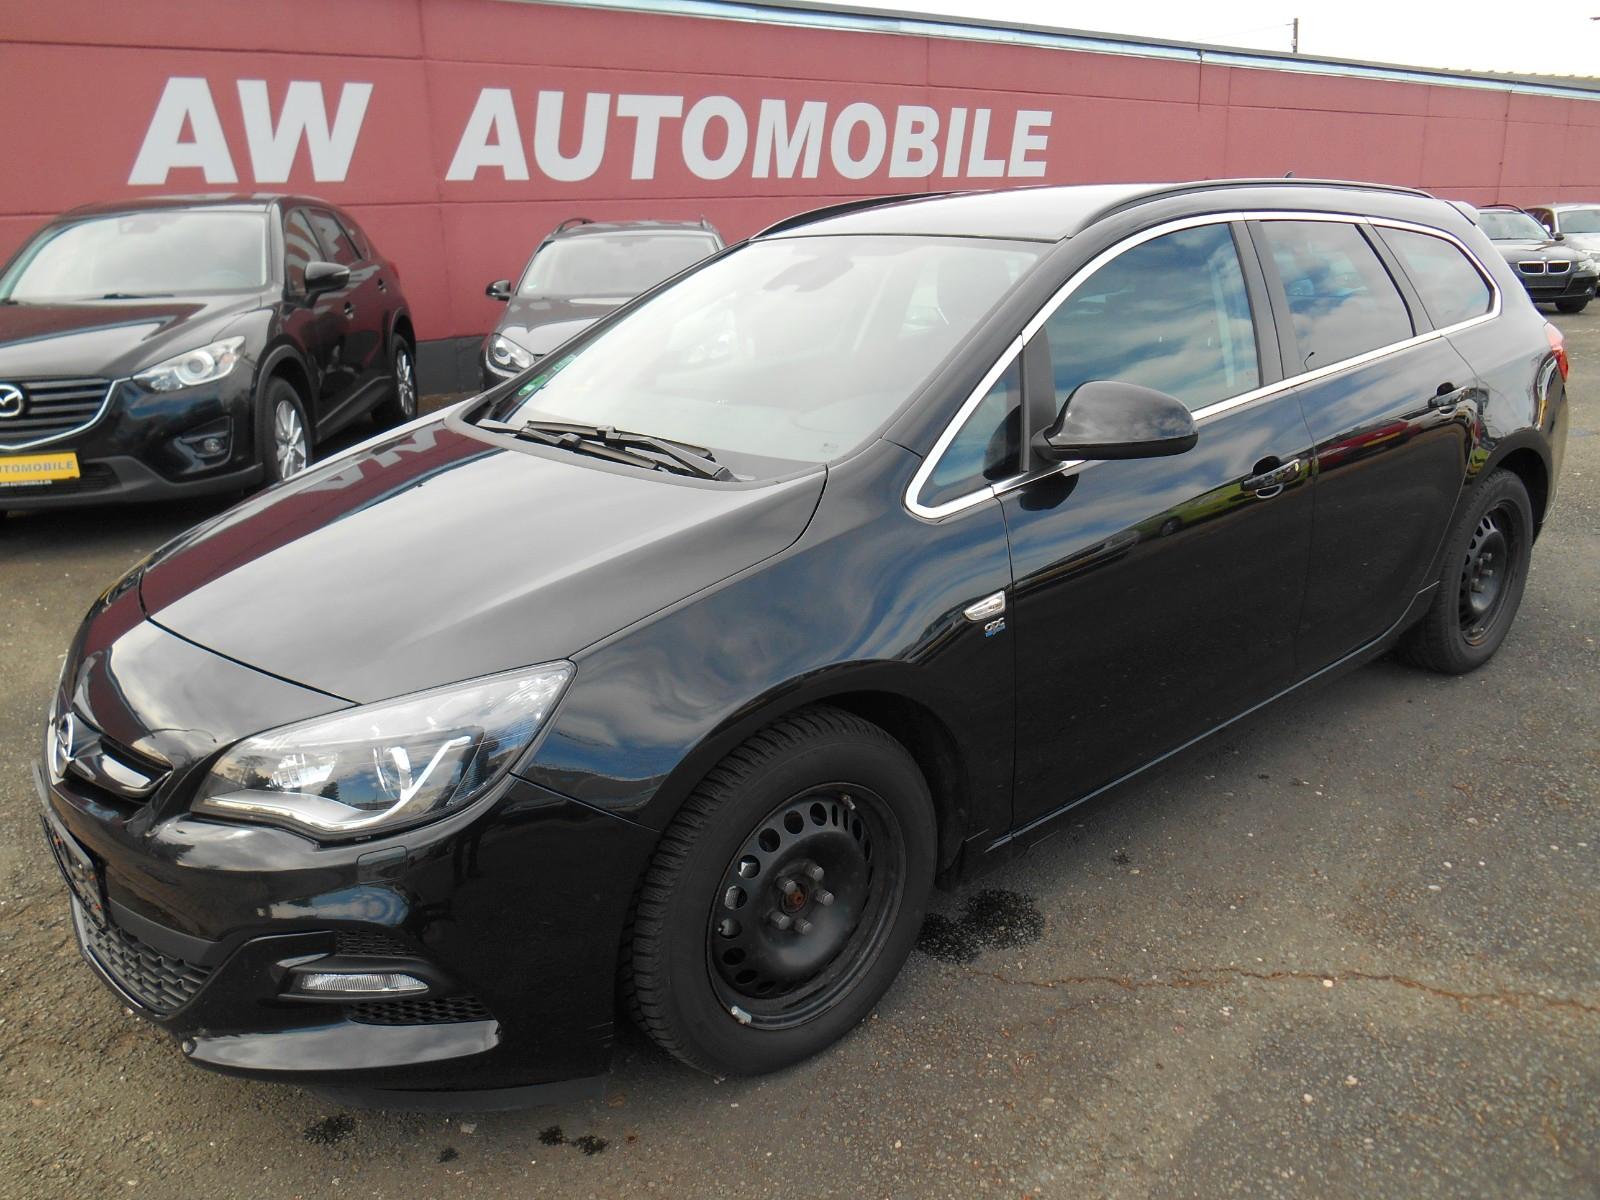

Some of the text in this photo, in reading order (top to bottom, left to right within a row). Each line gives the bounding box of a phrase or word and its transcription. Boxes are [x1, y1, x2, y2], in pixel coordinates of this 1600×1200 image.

[127, 77, 1053, 185] AW AUTOMOBILE
[0, 459, 74, 473] TOMOBILE
